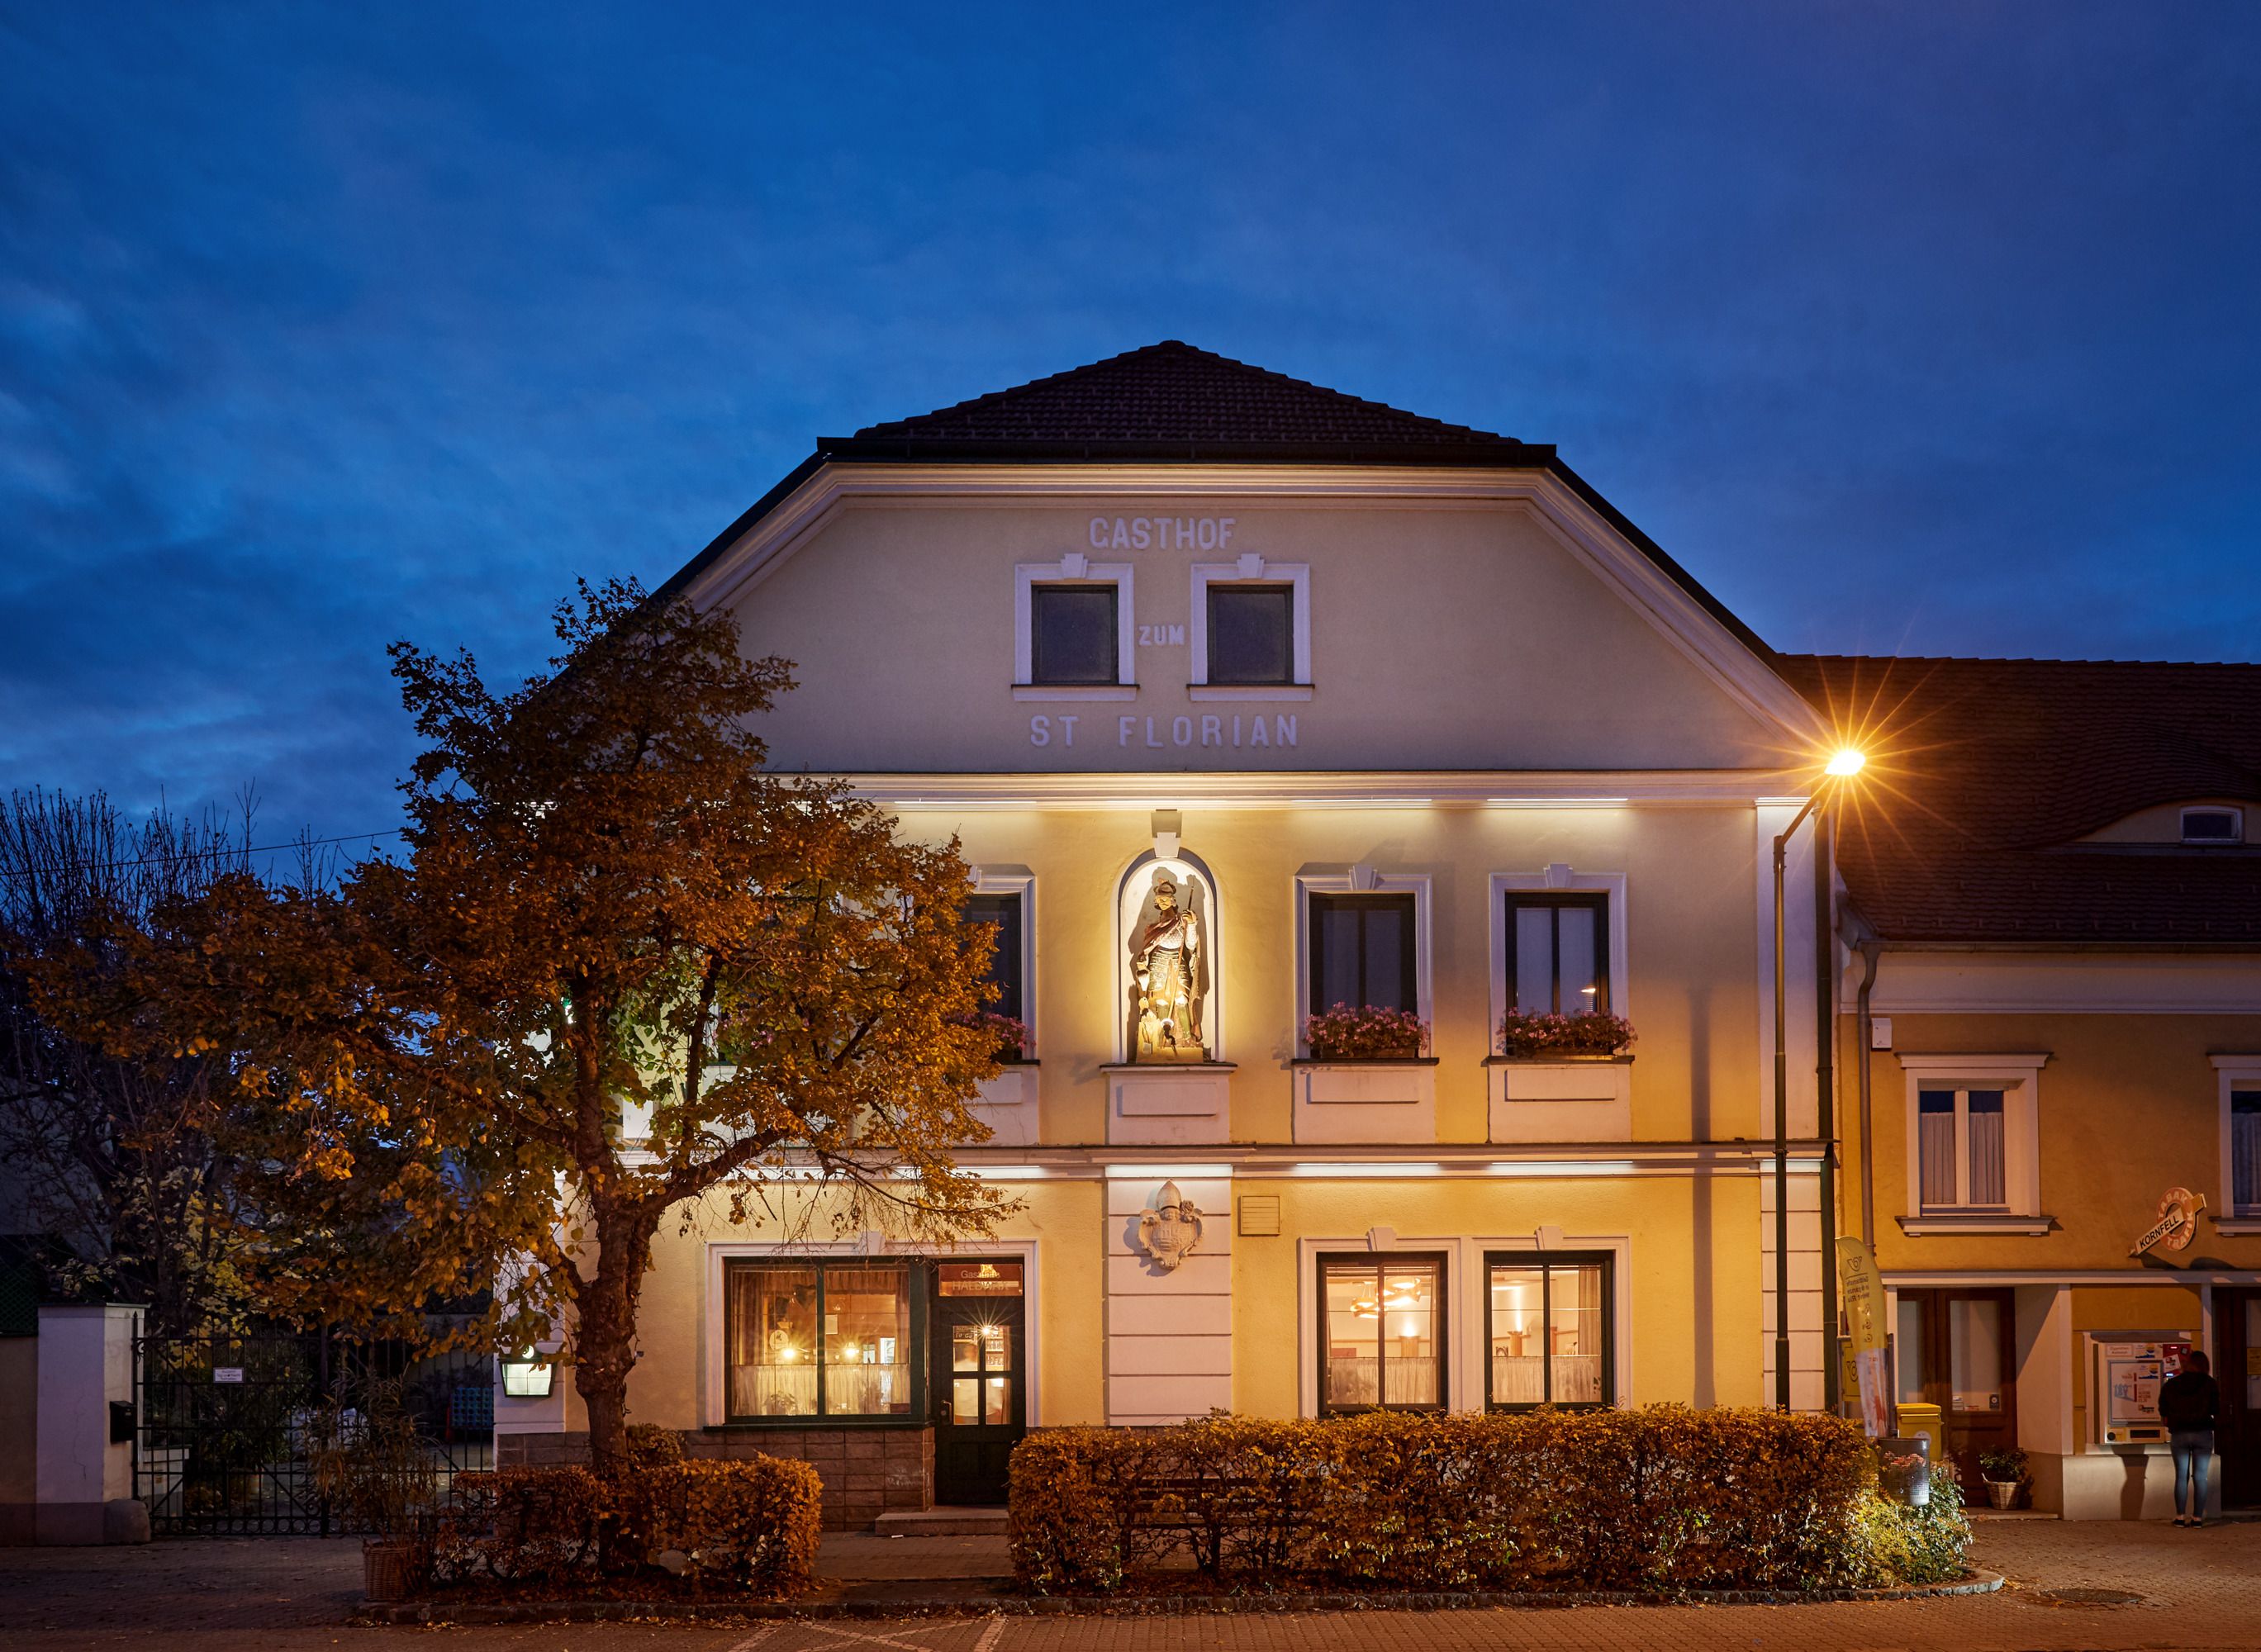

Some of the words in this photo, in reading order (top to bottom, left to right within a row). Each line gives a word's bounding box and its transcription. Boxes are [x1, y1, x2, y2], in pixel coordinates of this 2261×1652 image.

[1089, 517, 1236, 549] GASTHOF
[1138, 625, 1185, 646] ZUM
[1030, 715, 1079, 747] ST
[1119, 714, 1298, 748] FLORIAN
[2158, 1191, 2187, 1219] TABAK
[2140, 1215, 2179, 1249] KORNFELL
[2167, 1211, 2194, 1251] TRAFIK
